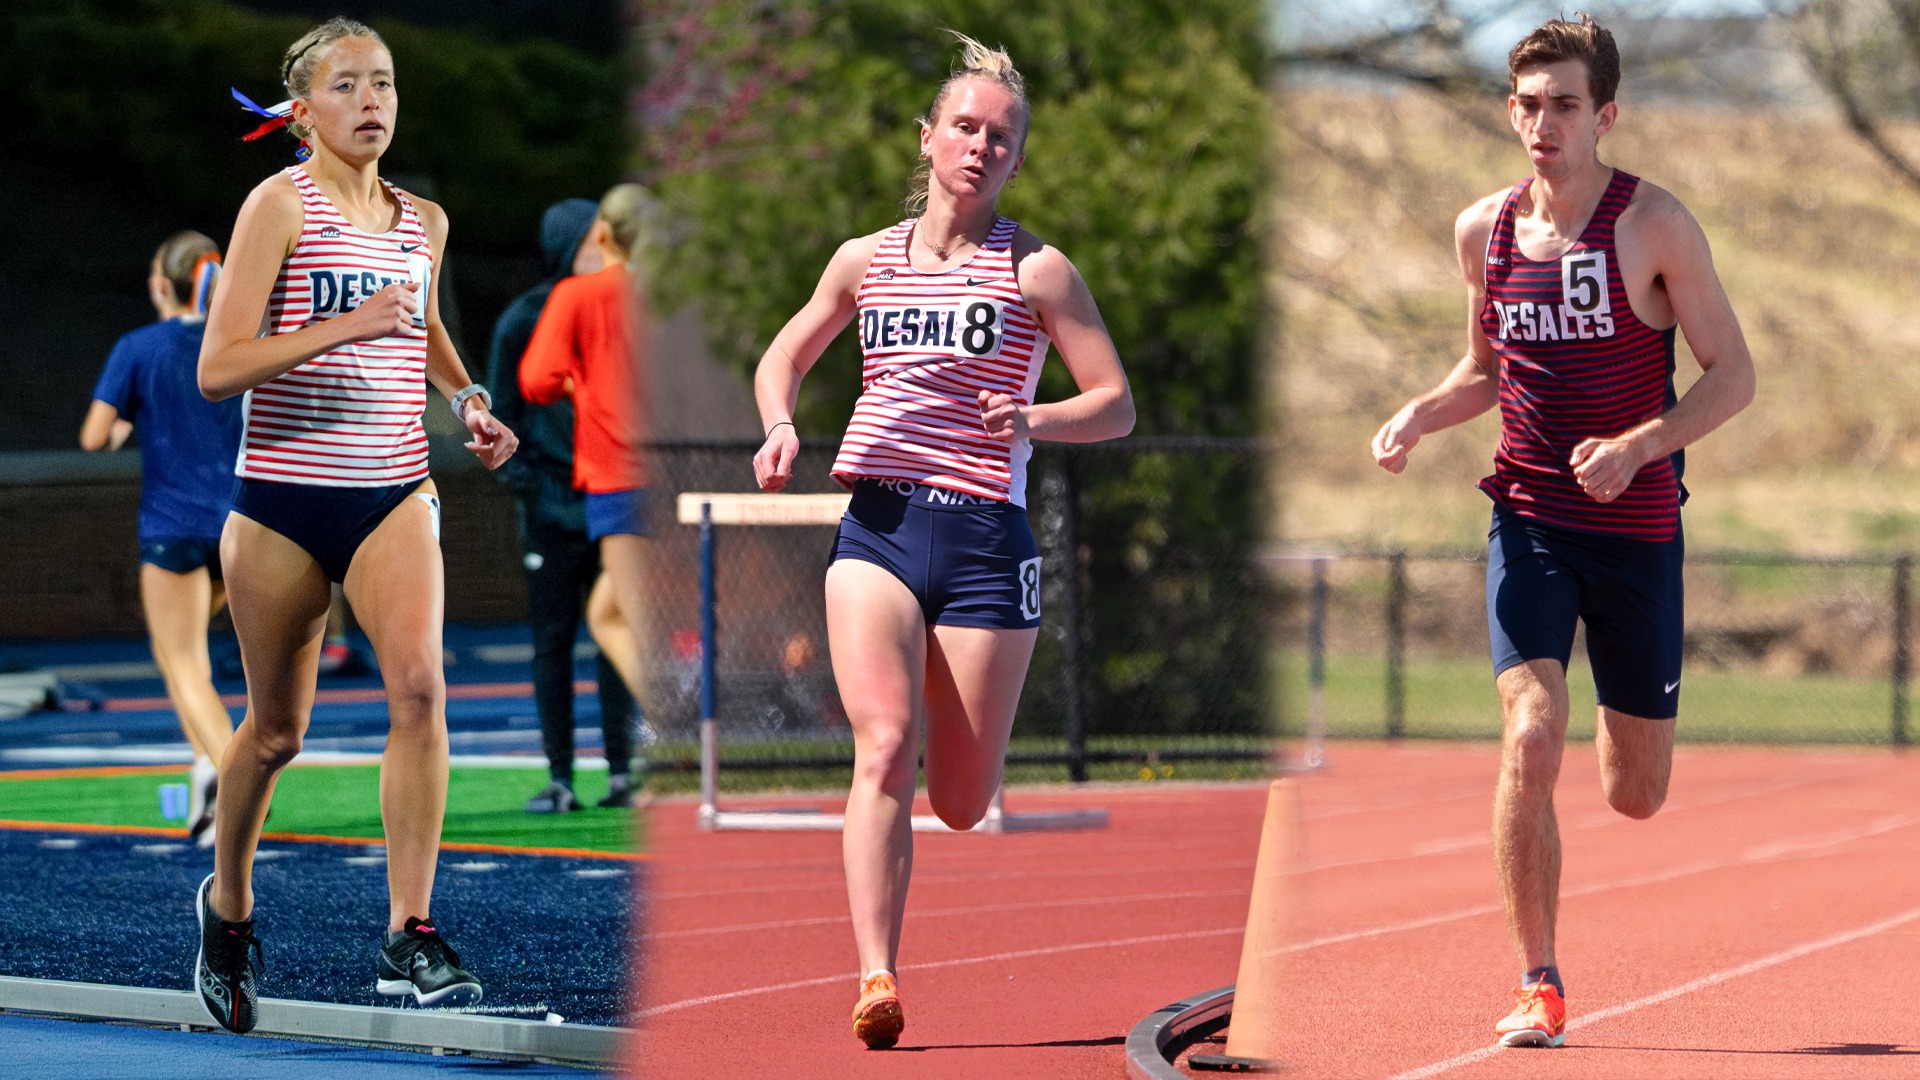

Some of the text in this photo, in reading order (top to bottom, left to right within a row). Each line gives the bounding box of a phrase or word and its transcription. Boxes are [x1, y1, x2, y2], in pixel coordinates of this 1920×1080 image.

[322, 230, 340, 238] MAC
[877, 272, 894, 280] MAC
[1487, 257, 1505, 265] MAC
[310, 270, 411, 313] DES
[1570, 259, 1600, 312] 5
[962, 302, 996, 355] 8
[1023, 562, 1039, 615] 8
